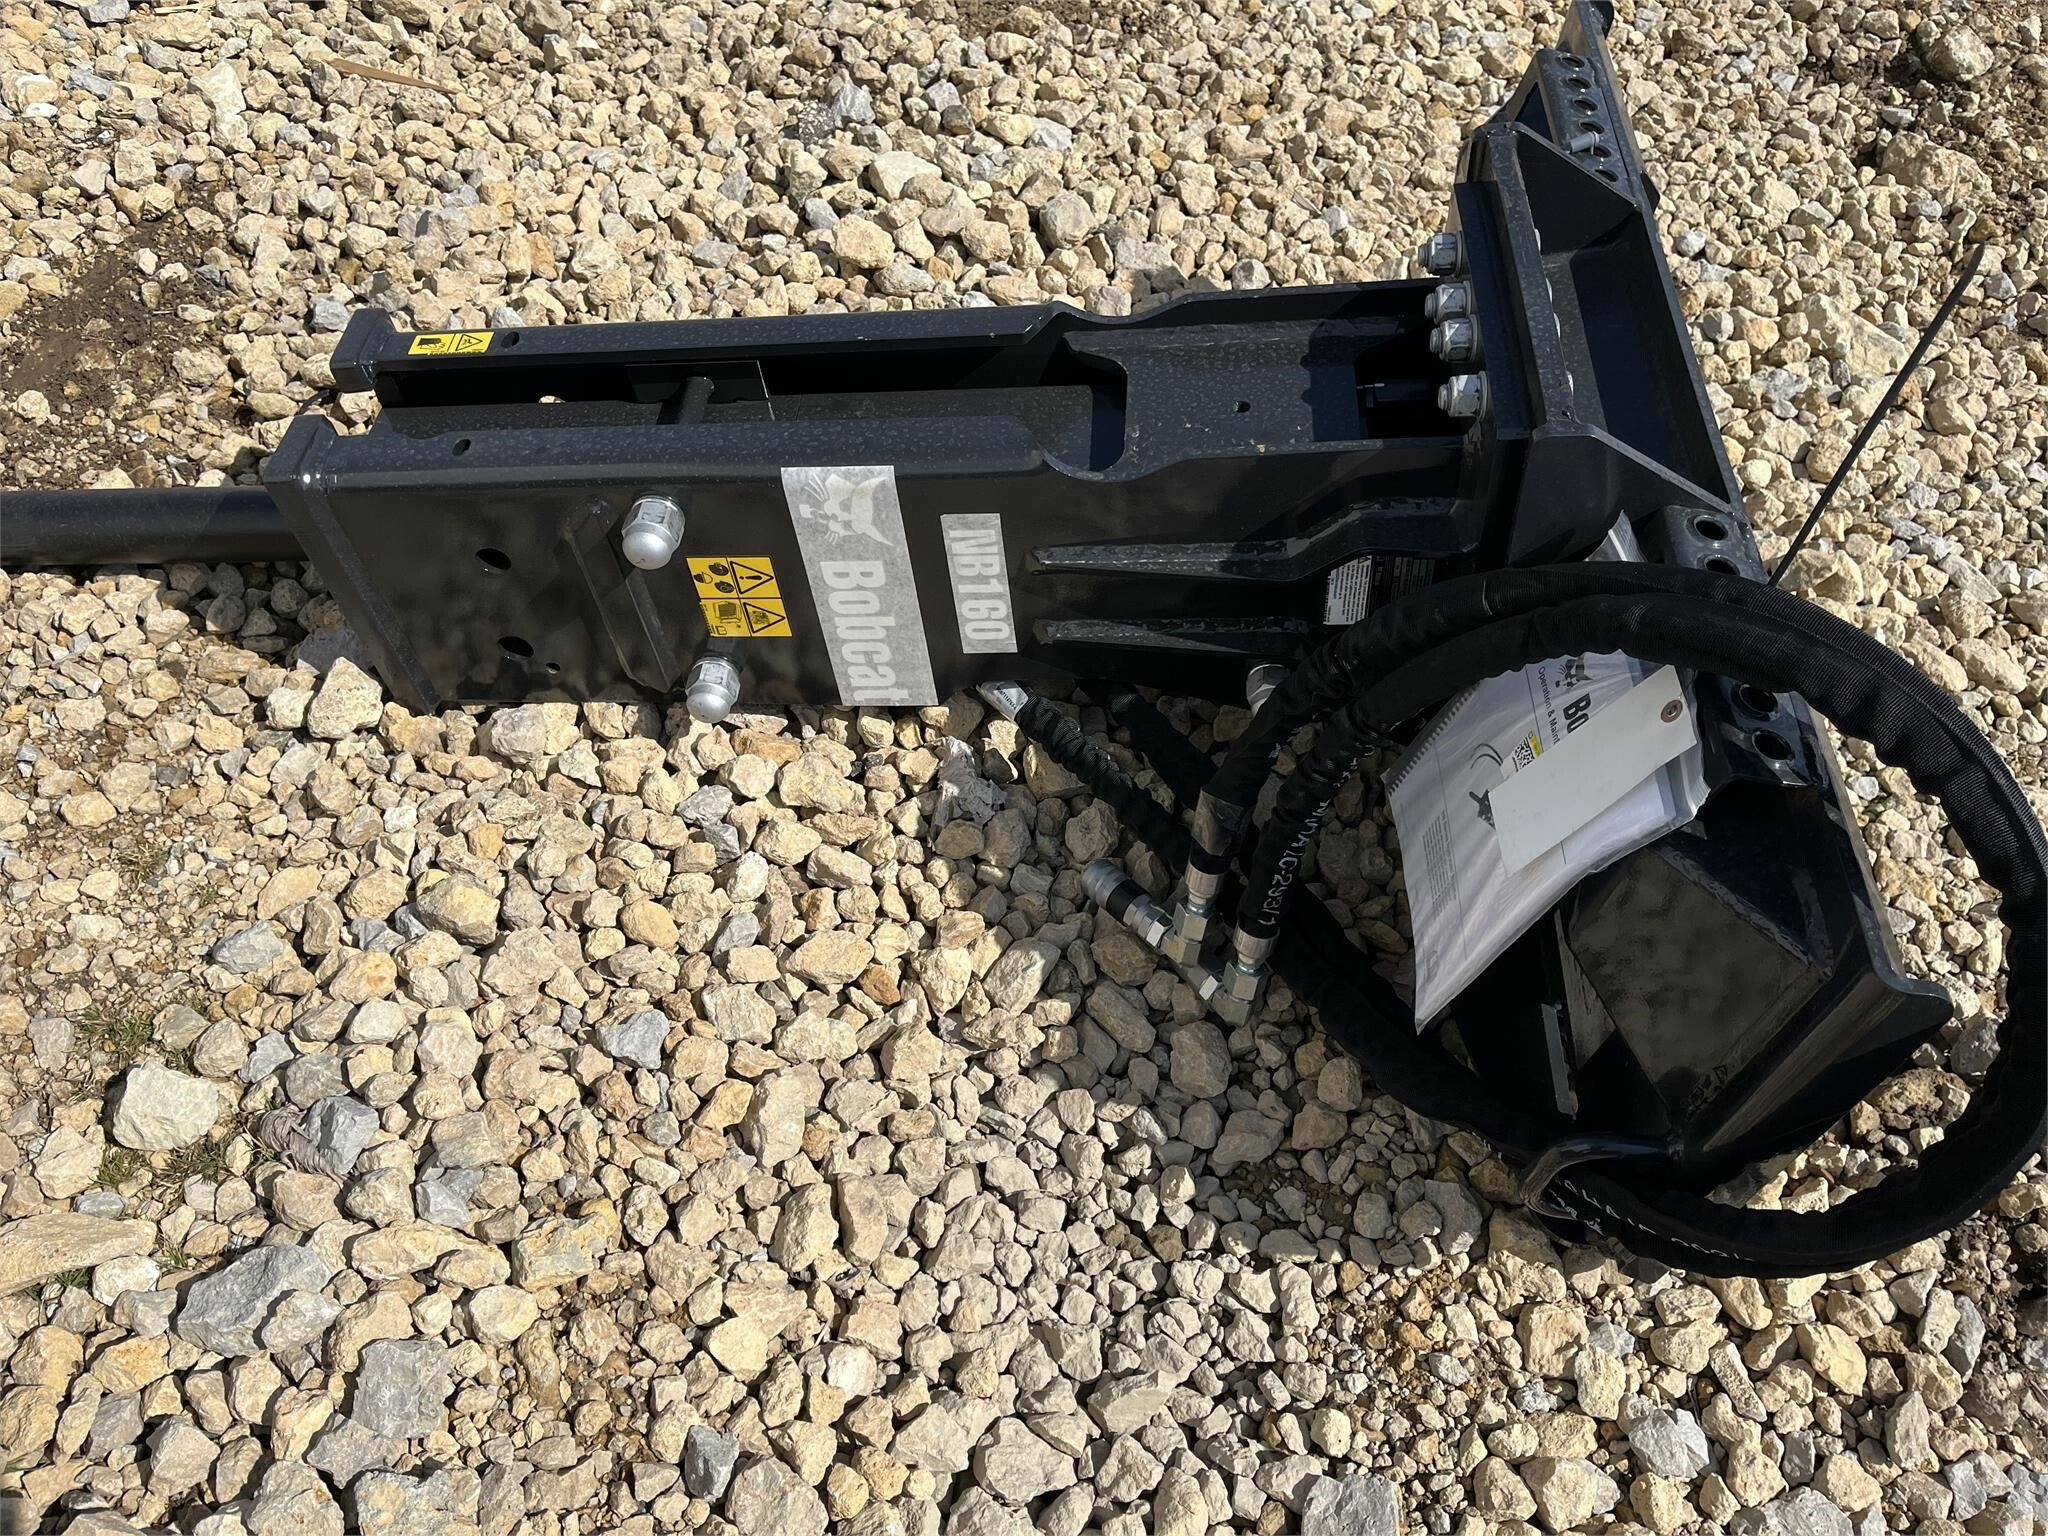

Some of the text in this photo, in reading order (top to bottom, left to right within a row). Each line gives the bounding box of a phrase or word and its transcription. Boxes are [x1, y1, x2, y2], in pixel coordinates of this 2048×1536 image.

[820, 560, 910, 705] Bobcat
[950, 529, 1010, 640] NB160
[1538, 666, 1551, 709] Operation
[1547, 709, 1555, 717] &
